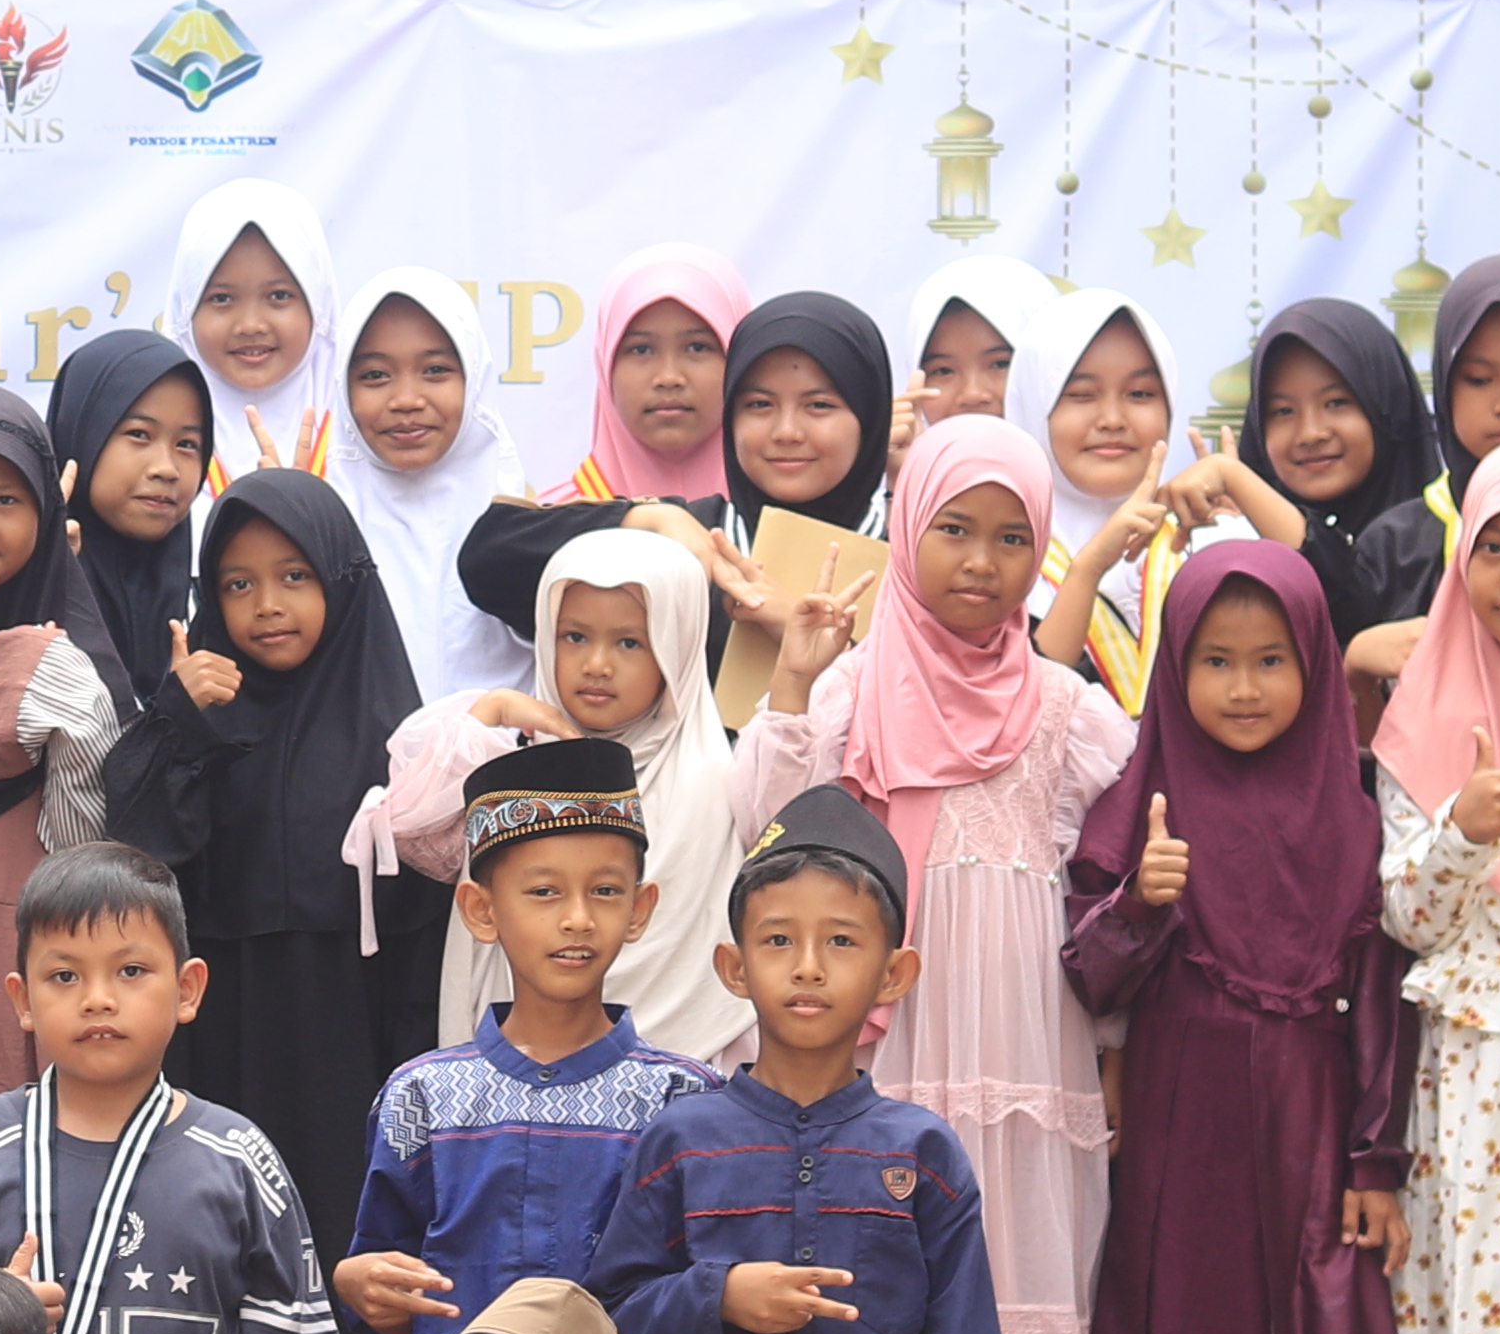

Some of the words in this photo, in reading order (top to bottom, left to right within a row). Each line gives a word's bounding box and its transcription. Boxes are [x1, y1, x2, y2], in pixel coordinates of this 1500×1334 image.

[128, 136, 188, 147] PONDOK
[191, 136, 278, 147] PESANTREN
[226, 1128, 288, 1191] QUALITY
